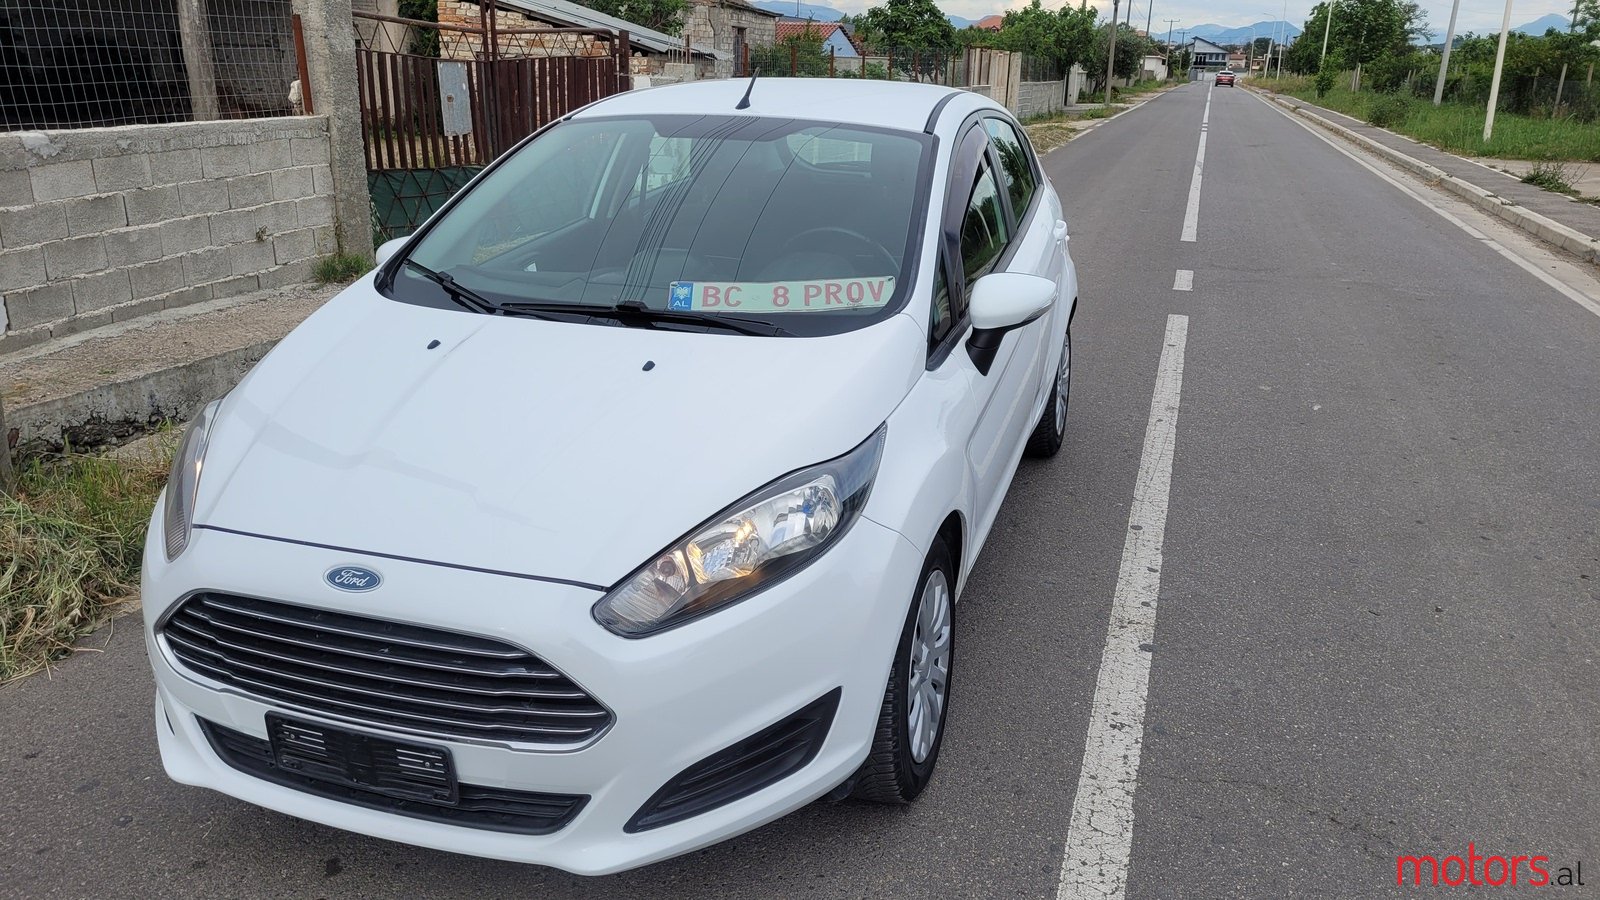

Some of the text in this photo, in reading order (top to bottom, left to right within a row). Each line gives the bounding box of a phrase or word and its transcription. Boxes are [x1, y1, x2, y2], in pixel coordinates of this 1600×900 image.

[701, 280, 885, 308] BC 8 PROV
[673, 300, 689, 308] AL
[335, 569, 370, 586] Ford
